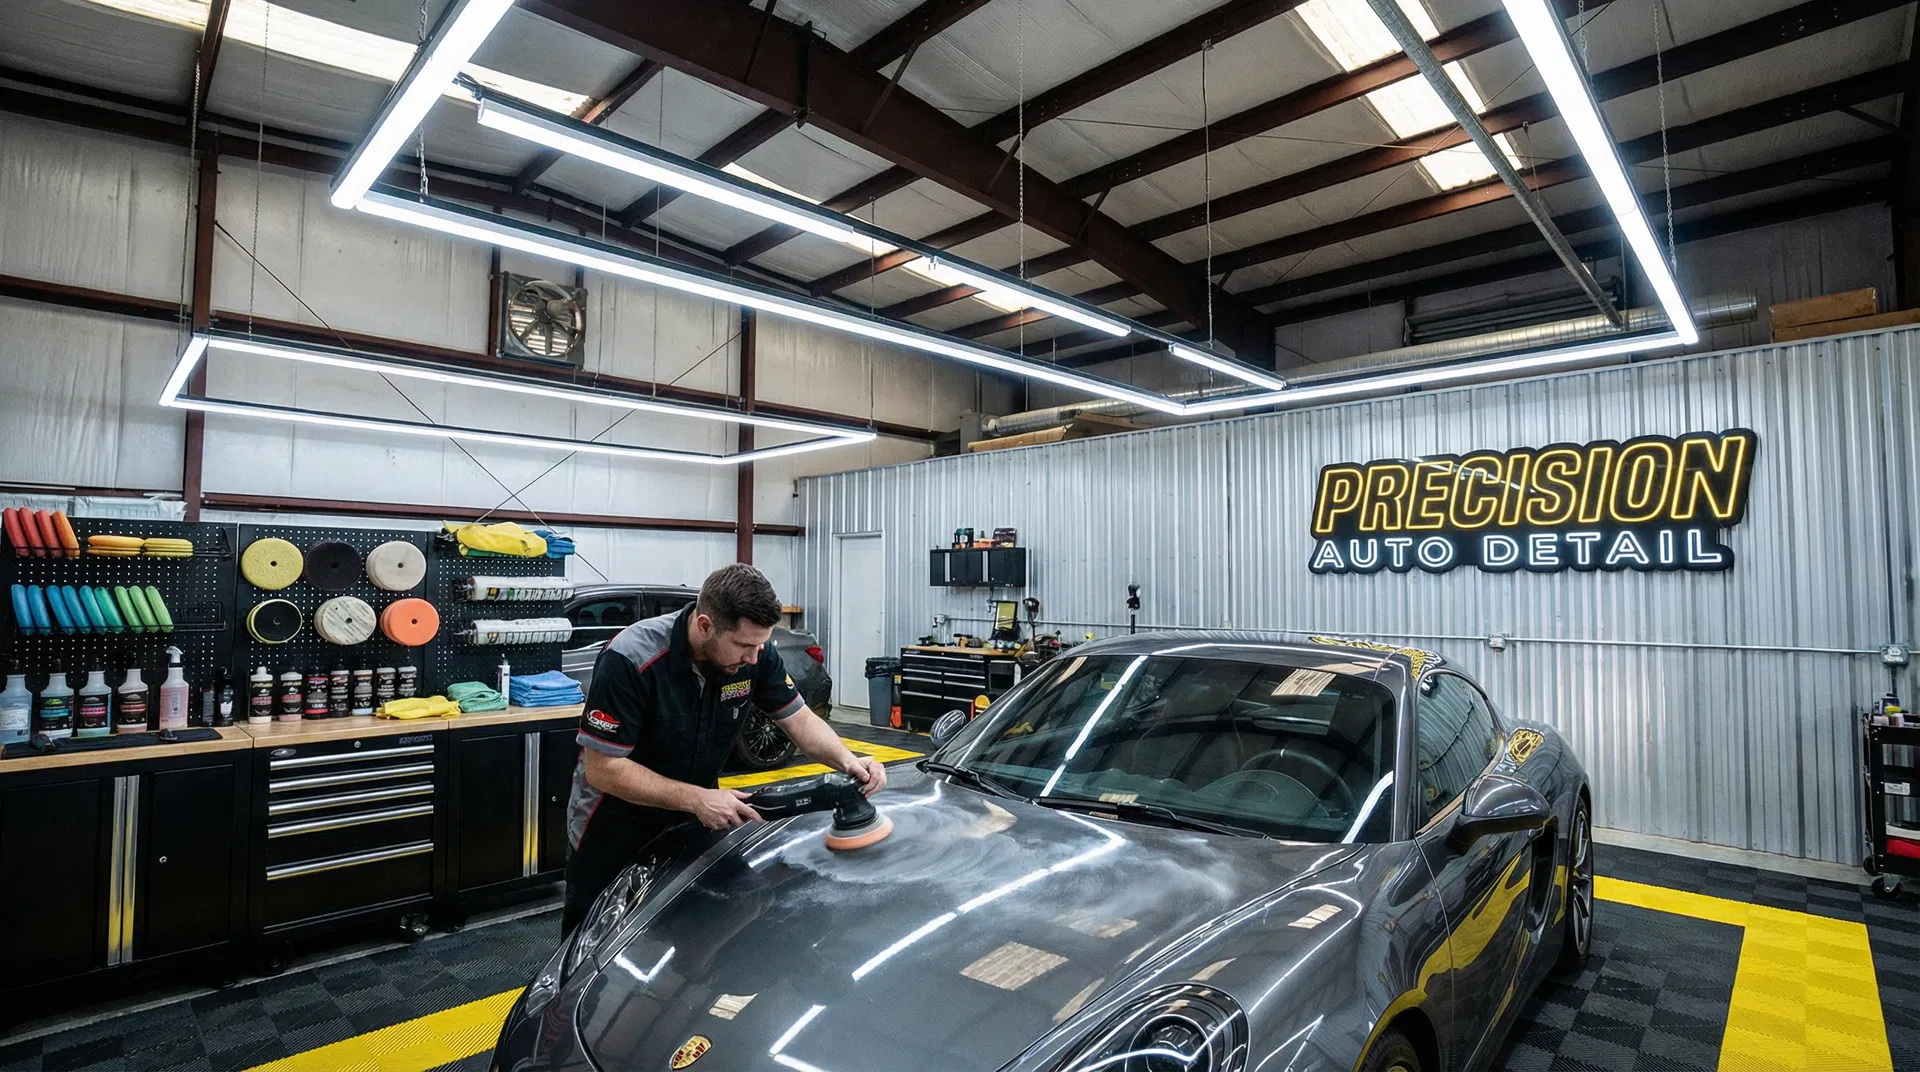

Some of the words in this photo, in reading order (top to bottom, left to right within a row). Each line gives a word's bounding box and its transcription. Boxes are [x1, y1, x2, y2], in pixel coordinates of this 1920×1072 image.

[1315, 435, 1746, 533] PRECISION
[1313, 536, 1454, 569] AUTO
[1483, 529, 1723, 567] DETAIL
